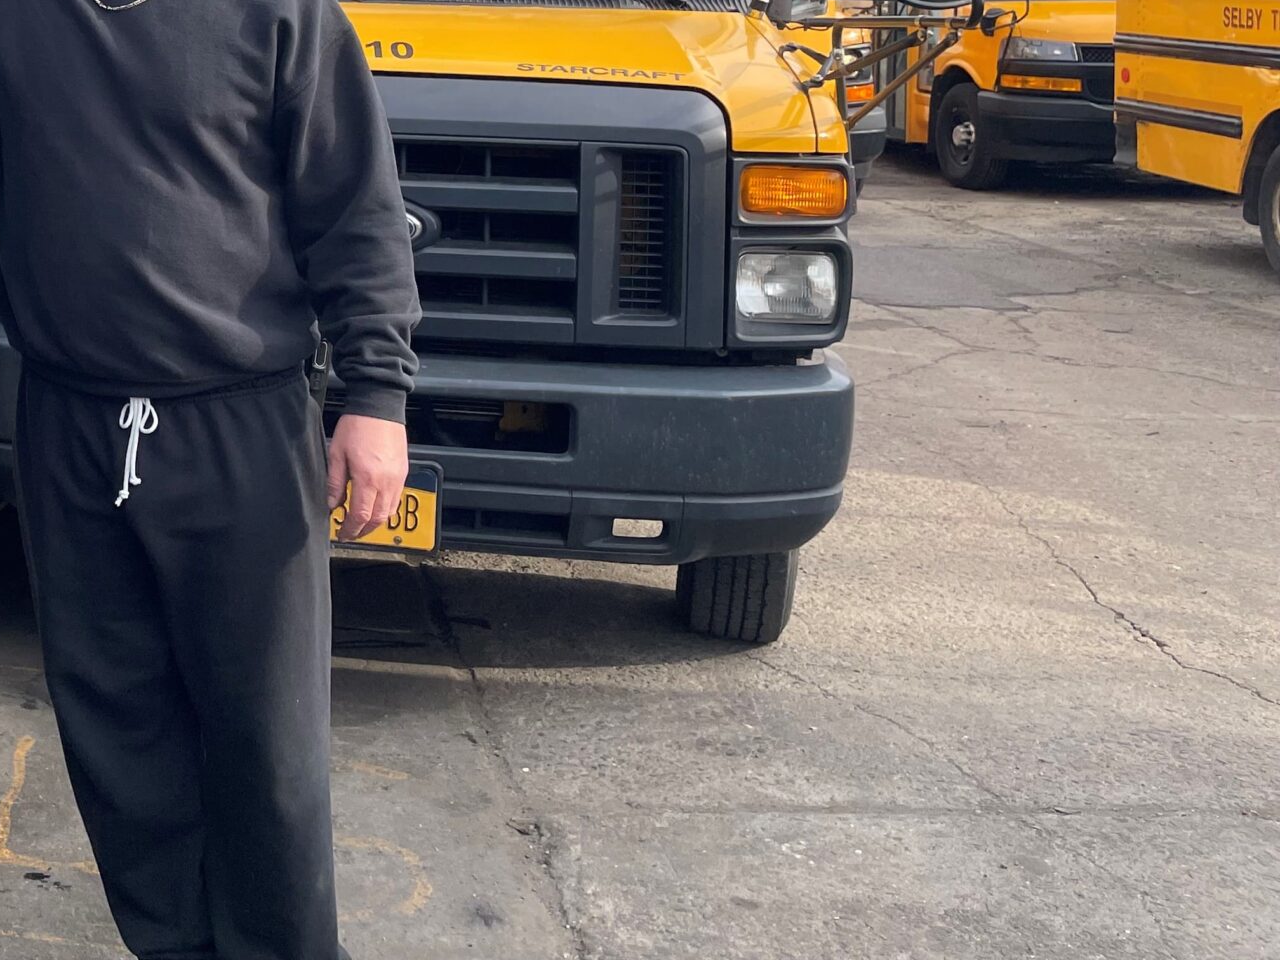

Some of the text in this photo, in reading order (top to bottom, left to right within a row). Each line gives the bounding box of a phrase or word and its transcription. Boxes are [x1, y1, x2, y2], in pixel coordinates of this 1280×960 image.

[1223, 6, 1280, 31] SELBY T
[365, 41, 414, 59] 10
[516, 63, 686, 81] STARCRAFT
